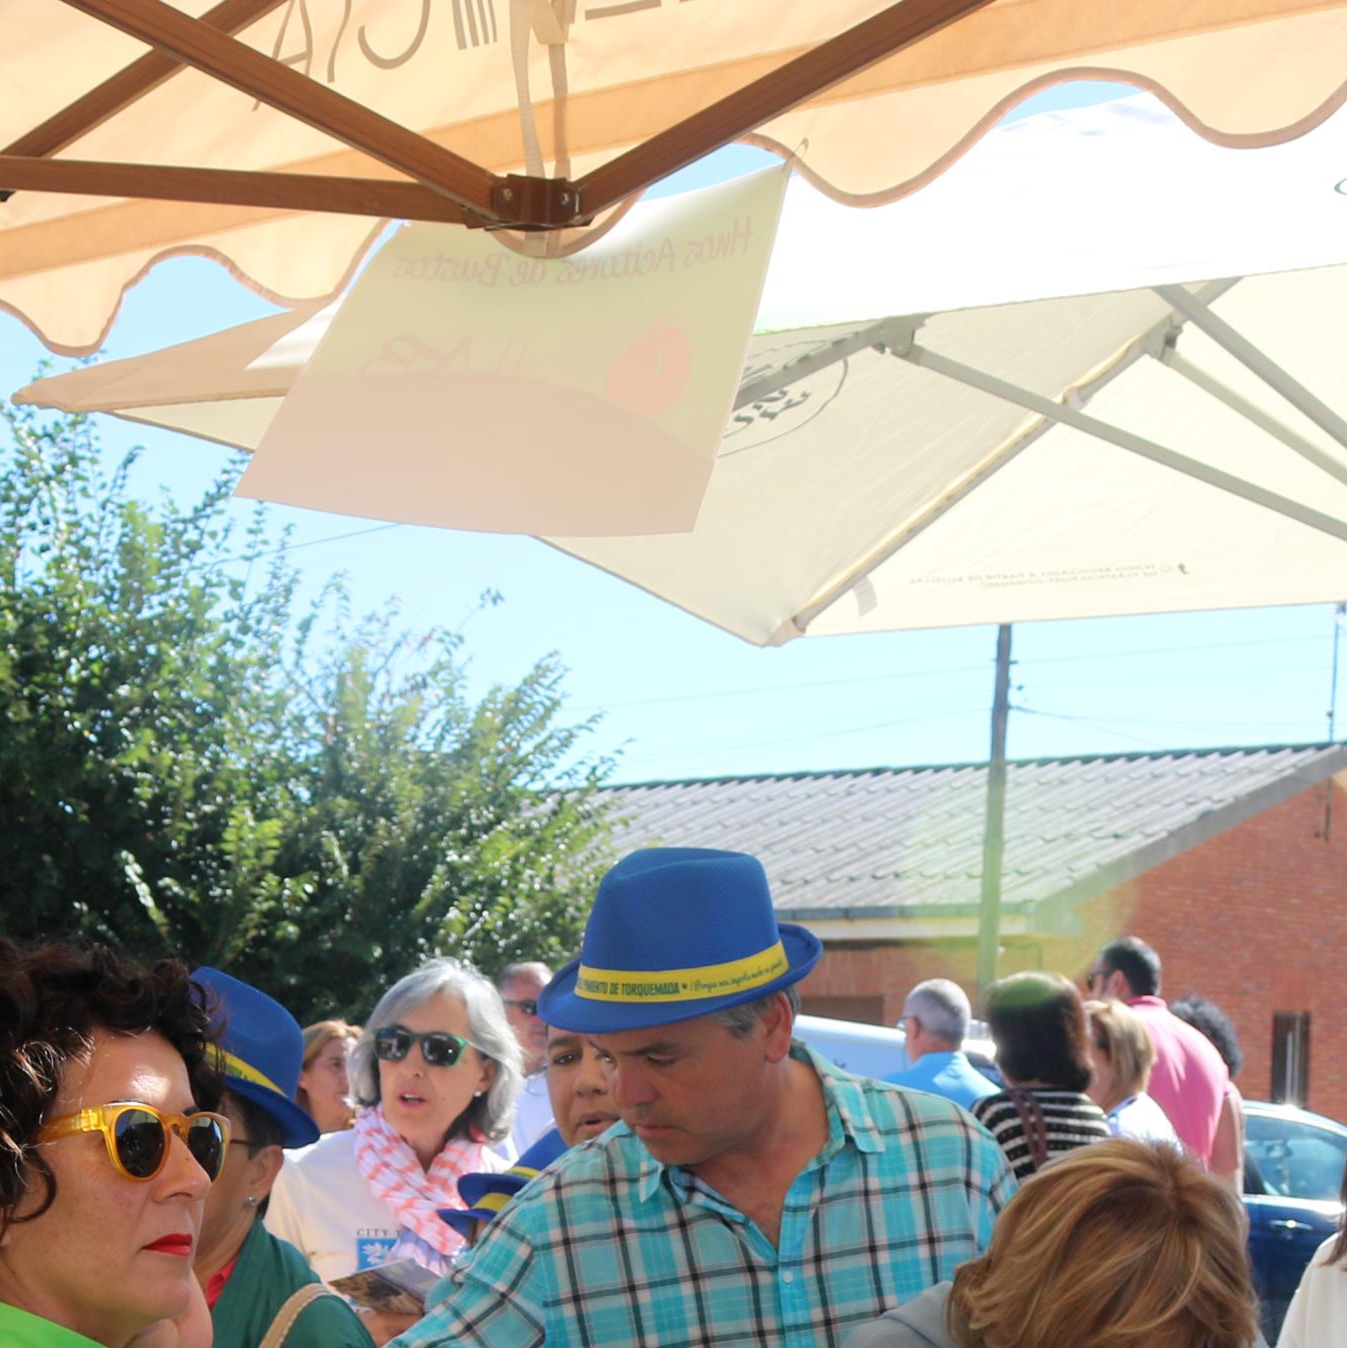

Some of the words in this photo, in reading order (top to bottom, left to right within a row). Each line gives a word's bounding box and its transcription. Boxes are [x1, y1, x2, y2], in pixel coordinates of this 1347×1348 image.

[609, 981, 619, 995] DE
[621, 981, 681, 997] TORQUEMADA
[356, 1228, 390, 1237] CITY
